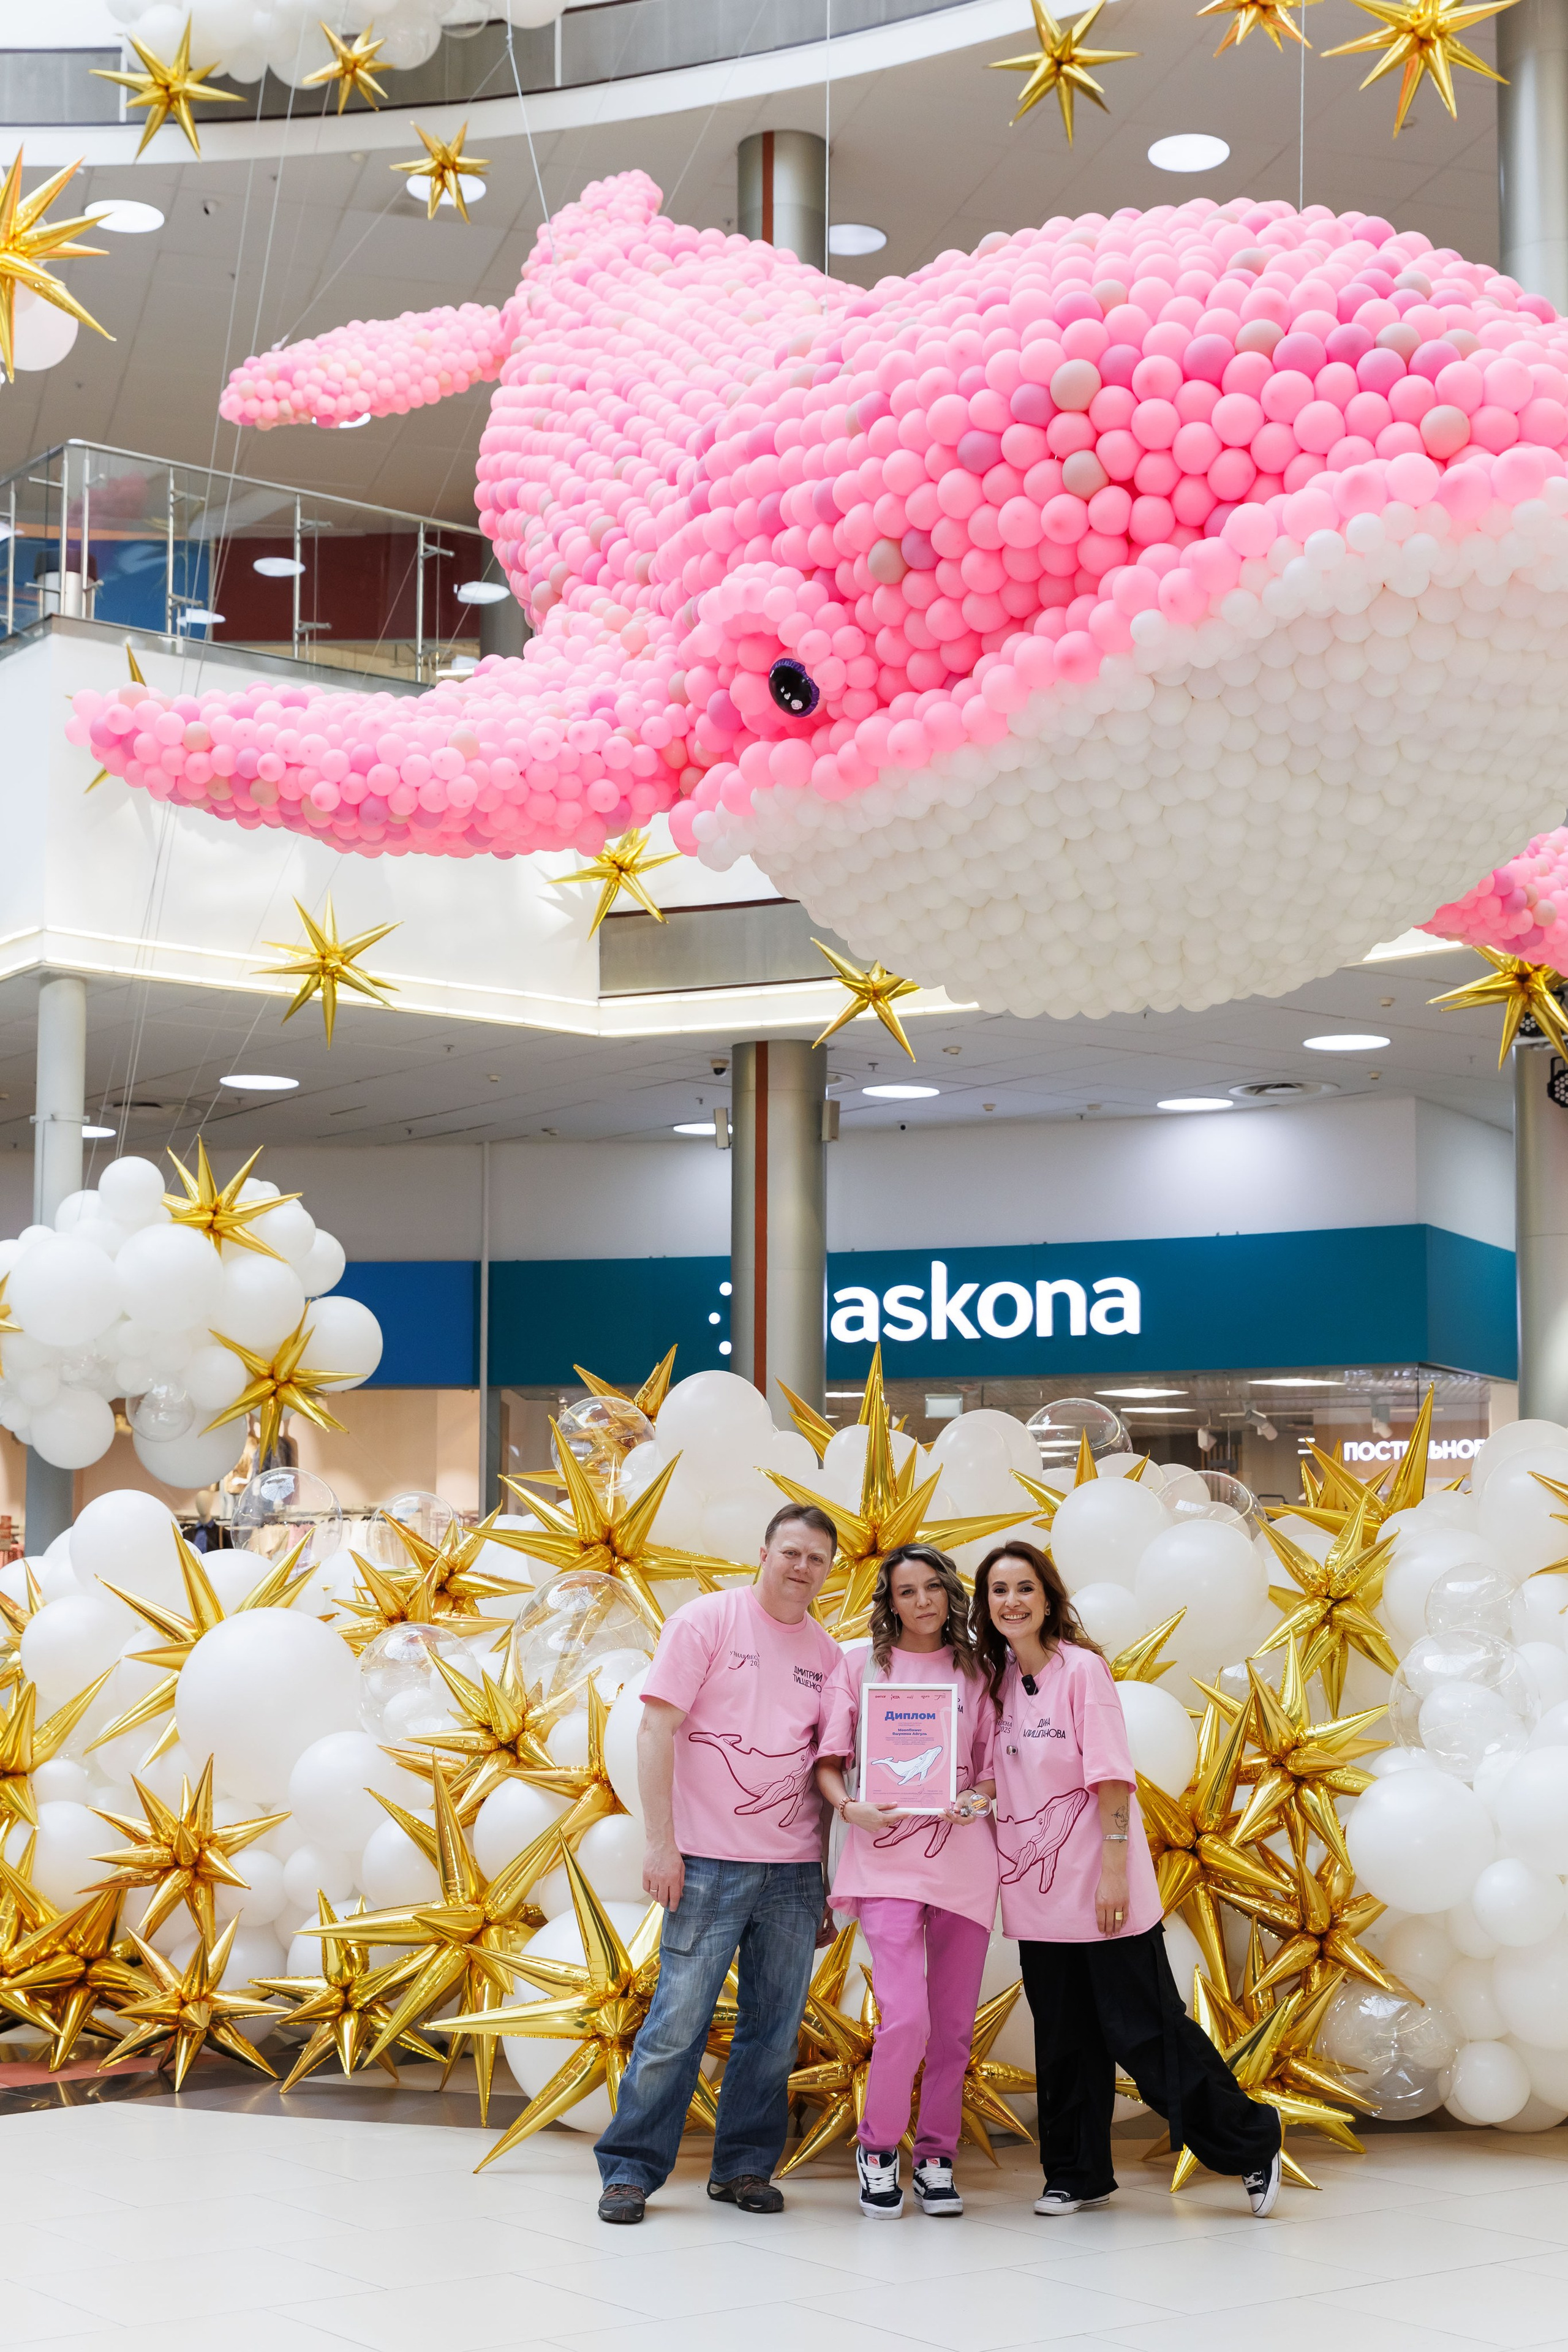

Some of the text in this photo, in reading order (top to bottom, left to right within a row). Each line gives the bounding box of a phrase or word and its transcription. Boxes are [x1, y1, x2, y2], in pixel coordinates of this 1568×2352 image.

[831, 1261, 1141, 1343] askona
[794, 1665, 823, 1682] ДМИТРИЙ
[793, 1673, 822, 1693] ТИЩЕНКО
[884, 1711, 936, 1721] Диплом
[1037, 1717, 1050, 1728] ДИНА
